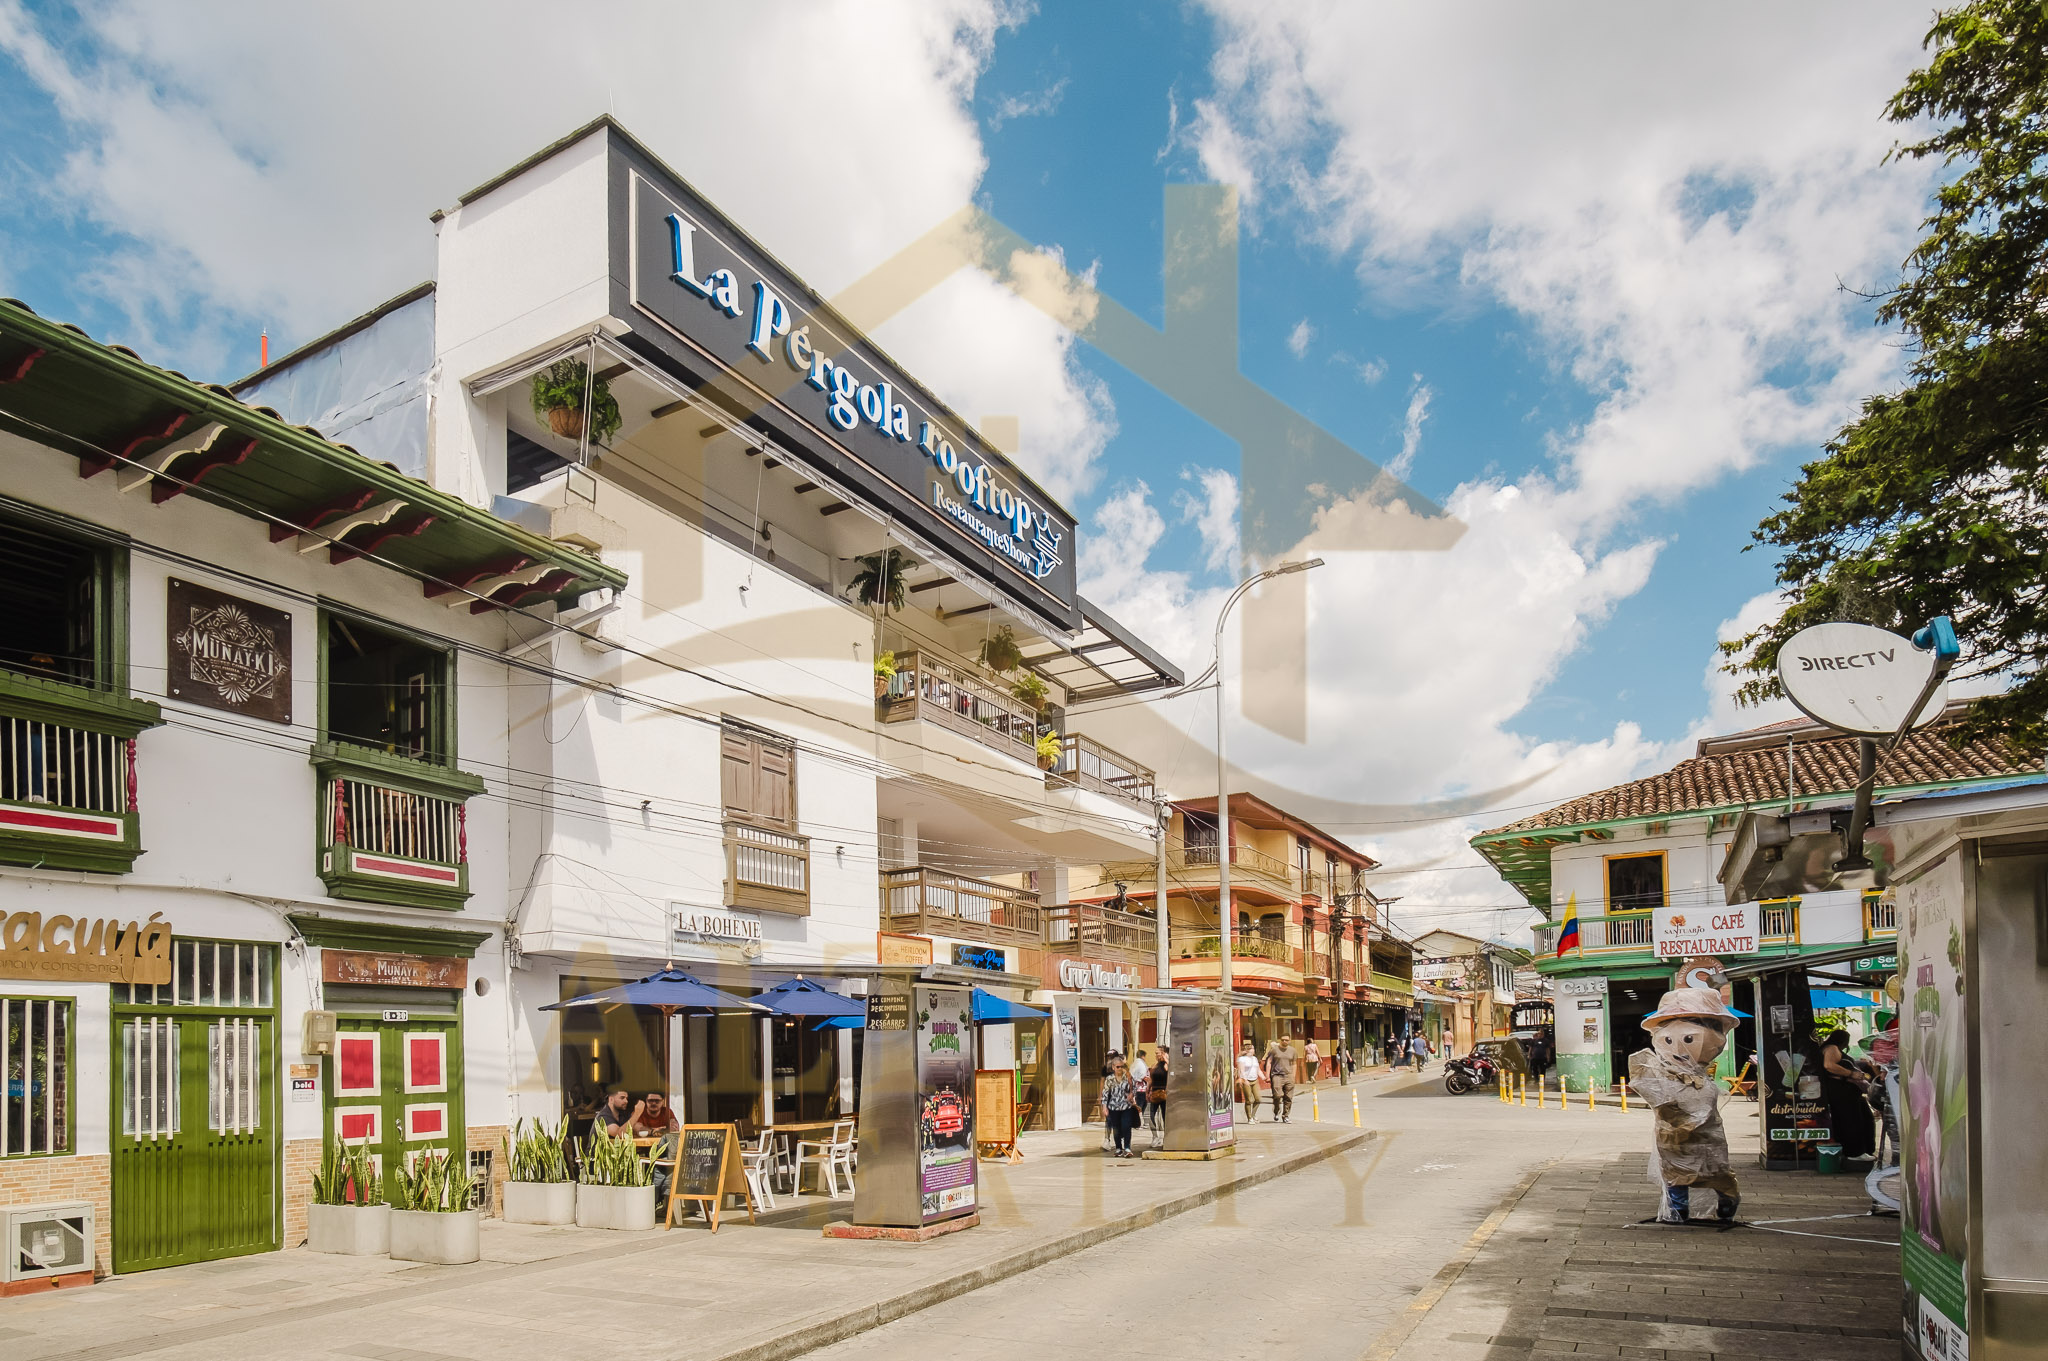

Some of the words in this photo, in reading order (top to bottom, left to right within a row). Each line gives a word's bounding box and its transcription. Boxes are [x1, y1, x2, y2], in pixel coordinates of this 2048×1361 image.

[668, 212, 743, 318] La
[746, 279, 912, 442] Pérgola
[920, 419, 1033, 541] rooftop
[1797, 648, 1895, 671] DIRECTV
[678, 912, 697, 931] LA
[703, 914, 760, 938] BOHÈME
[1711, 910, 1745, 930] CAFÉ
[0, 910, 172, 982] acuyá
[900, 945, 928, 956] HEIRLOOM
[1660, 937, 1754, 955] RESTAURANTE
[41, 960, 119, 974] consciente
[905, 955, 923, 965] COFFEE
[1060, 959, 1092, 988] Cruz
[1090, 964, 1129, 990] Verde
[1561, 977, 1606, 994] Café
[294, 1081, 312, 1089] bold
